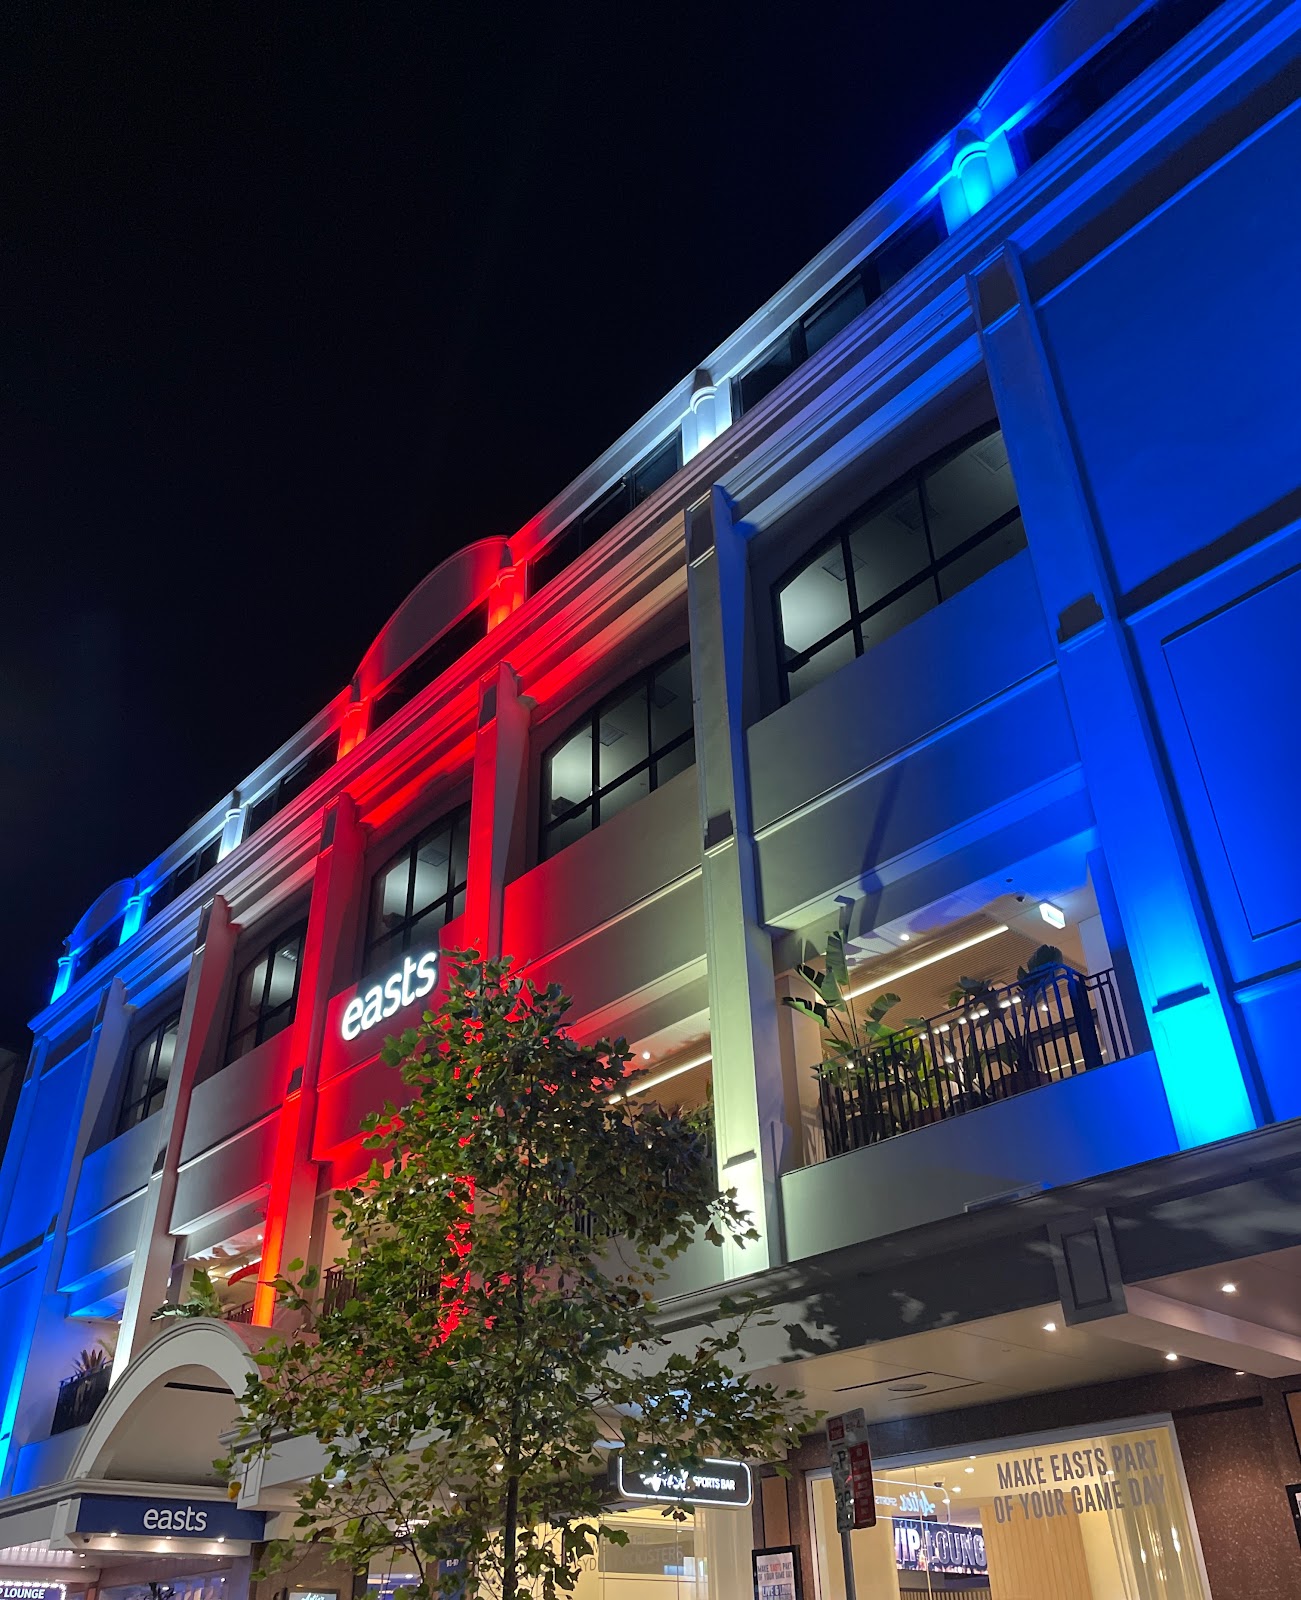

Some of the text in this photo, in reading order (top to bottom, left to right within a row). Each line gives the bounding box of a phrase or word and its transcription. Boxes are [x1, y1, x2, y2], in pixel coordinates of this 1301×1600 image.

[341, 951, 437, 1041] easts
[996, 1440, 1159, 1489] MAKE EASTS PART
[720, 1478, 736, 1490] BAR
[993, 1474, 1167, 1524] OF YOUR GAME DAY
[143, 1505, 208, 1532] easts
[4, 1587, 46, 1599] LOUNGE
